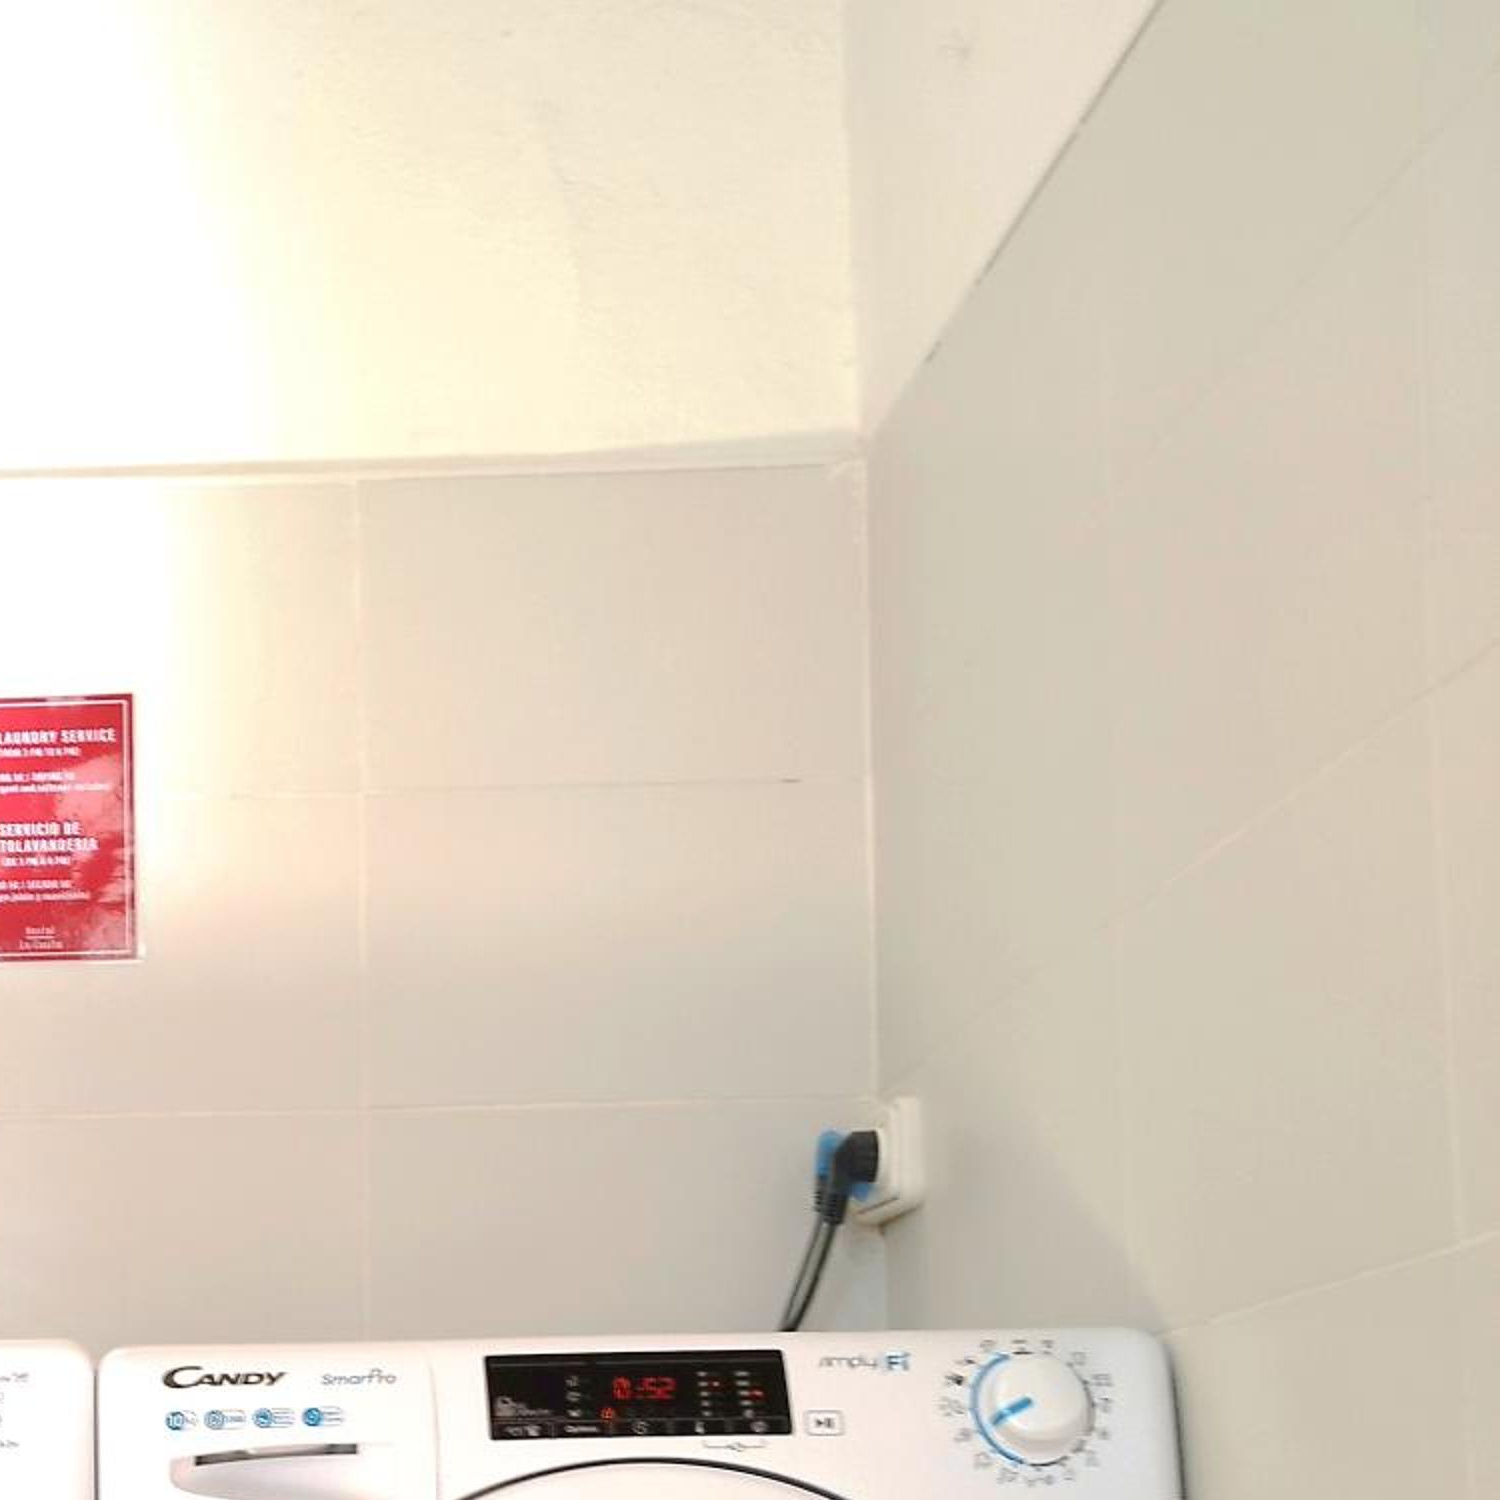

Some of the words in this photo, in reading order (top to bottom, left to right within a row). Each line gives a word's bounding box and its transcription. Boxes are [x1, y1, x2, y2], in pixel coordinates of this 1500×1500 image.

[60, 727, 117, 743] SERVICE
[63, 821, 81, 835] DE
[161, 1365, 286, 1389] CANDY
